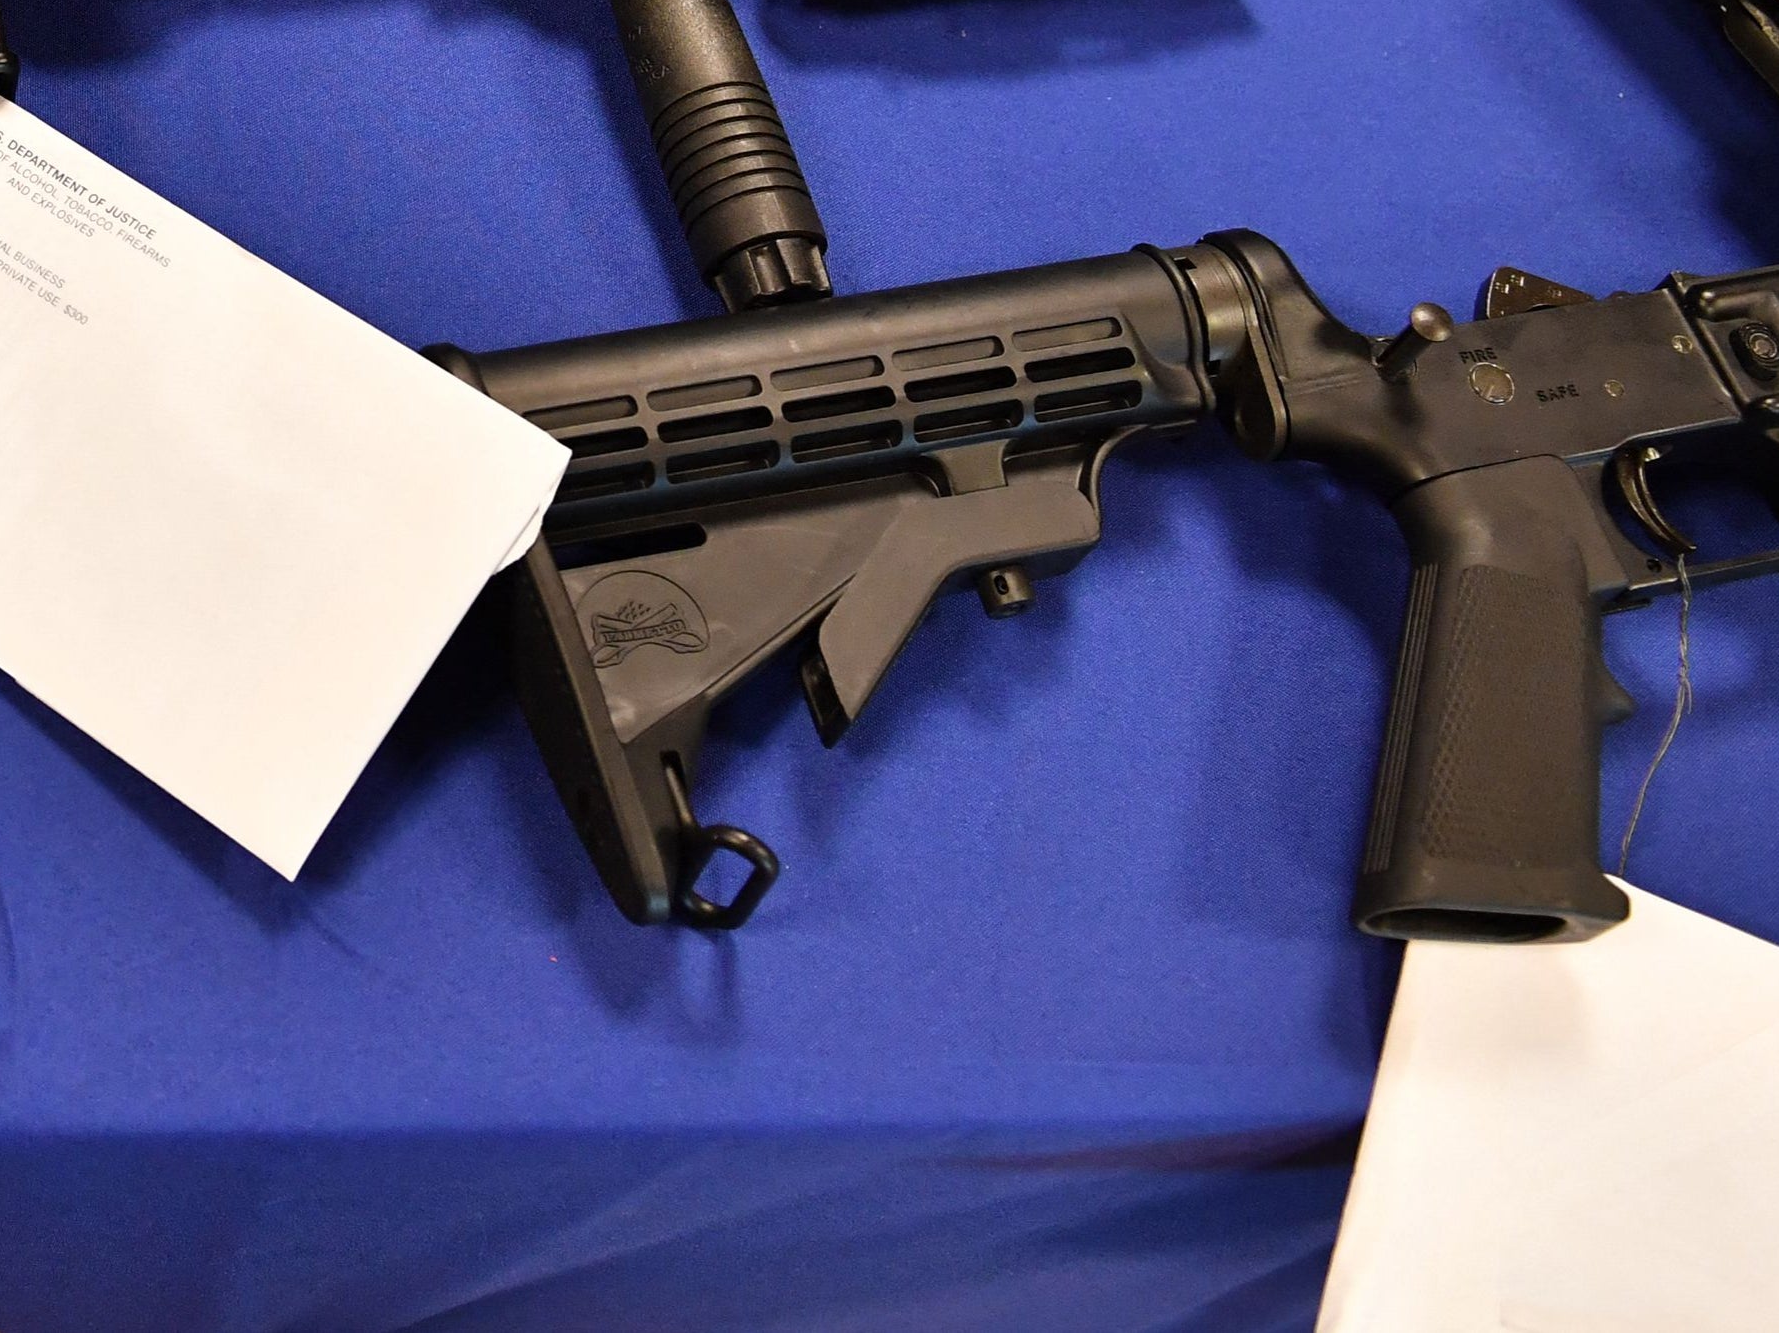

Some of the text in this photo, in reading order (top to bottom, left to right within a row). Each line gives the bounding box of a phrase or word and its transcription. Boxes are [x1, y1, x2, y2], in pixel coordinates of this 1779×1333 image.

[6, 177, 95, 237] AND EXPLOSIVES
[7, 139, 88, 197] DEPARTMENT
[88, 193, 106, 207] OF
[105, 205, 157, 240] JUSTICE
[115, 229, 171, 268] FIREARMS
[13, 251, 66, 289] BUSINESS
[37, 287, 61, 307] USE
[63, 304, 89, 325] $300
[1459, 347, 1498, 364] FIRE
[1535, 384, 1580, 402] SAFE
